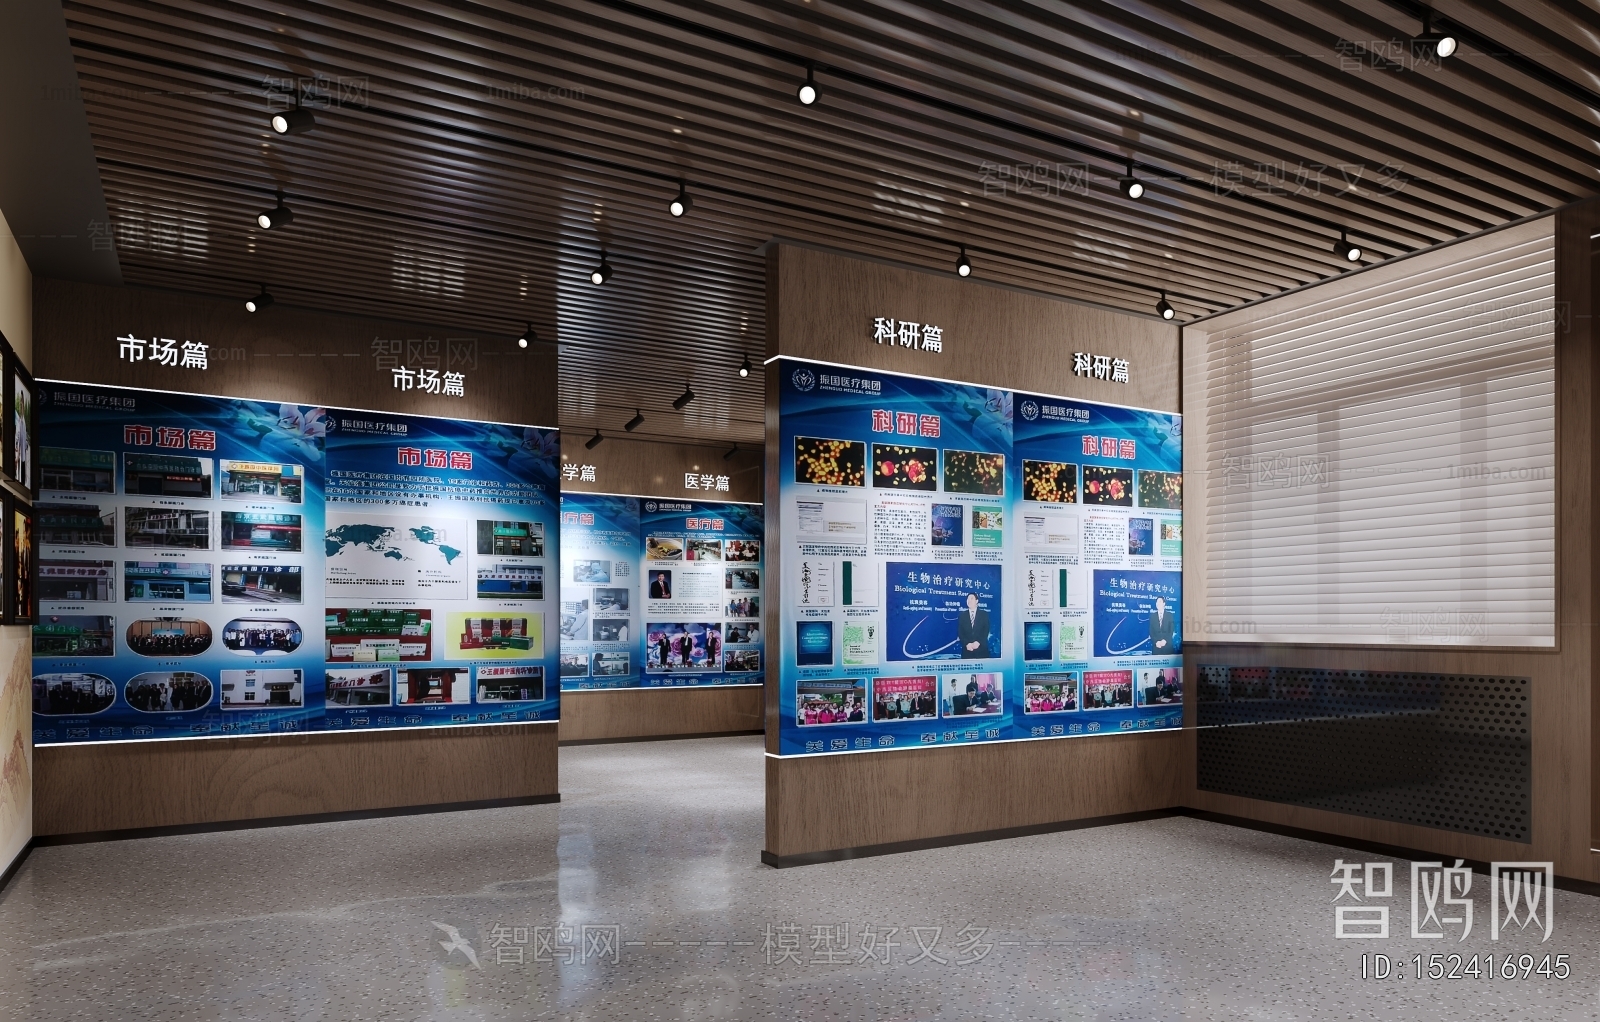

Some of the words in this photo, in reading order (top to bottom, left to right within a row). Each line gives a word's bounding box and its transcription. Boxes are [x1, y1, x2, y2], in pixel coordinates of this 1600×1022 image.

[874, 317, 943, 353] 科研篇
[117, 333, 209, 370] 市场篇
[1074, 352, 1130, 383] 科研篇
[392, 366, 465, 397] 市场篇
[820, 374, 881, 391] 振国医疗集团
[54, 391, 136, 408] 振国医疗集团
[1042, 405, 1090, 419] 振国医疗集团
[341, 419, 408, 433] 振国医疗集团
[872, 409, 941, 438] 科研篇
[123, 424, 216, 451] 市场篇
[1082, 434, 1136, 460] 科研篇
[397, 447, 473, 470] 市场篇
[560, 463, 597, 482] 学篇
[684, 472, 730, 492] 医学篇
[560, 512, 594, 526] 疗篇
[686, 518, 725, 531] 医疗篇
[907, 572, 991, 590] 生物治疗研究中心
[1109, 578, 1175, 594] 生物治疗研究中心
[894, 585, 927, 595] Biological
[928, 587, 956, 596] Treatment
[1099, 590, 1125, 599] Biological
[1031, 721, 1101, 737] 关爱生命
[806, 734, 895, 752] 关爱生命
[921, 727, 1000, 743] 奉献至诚
